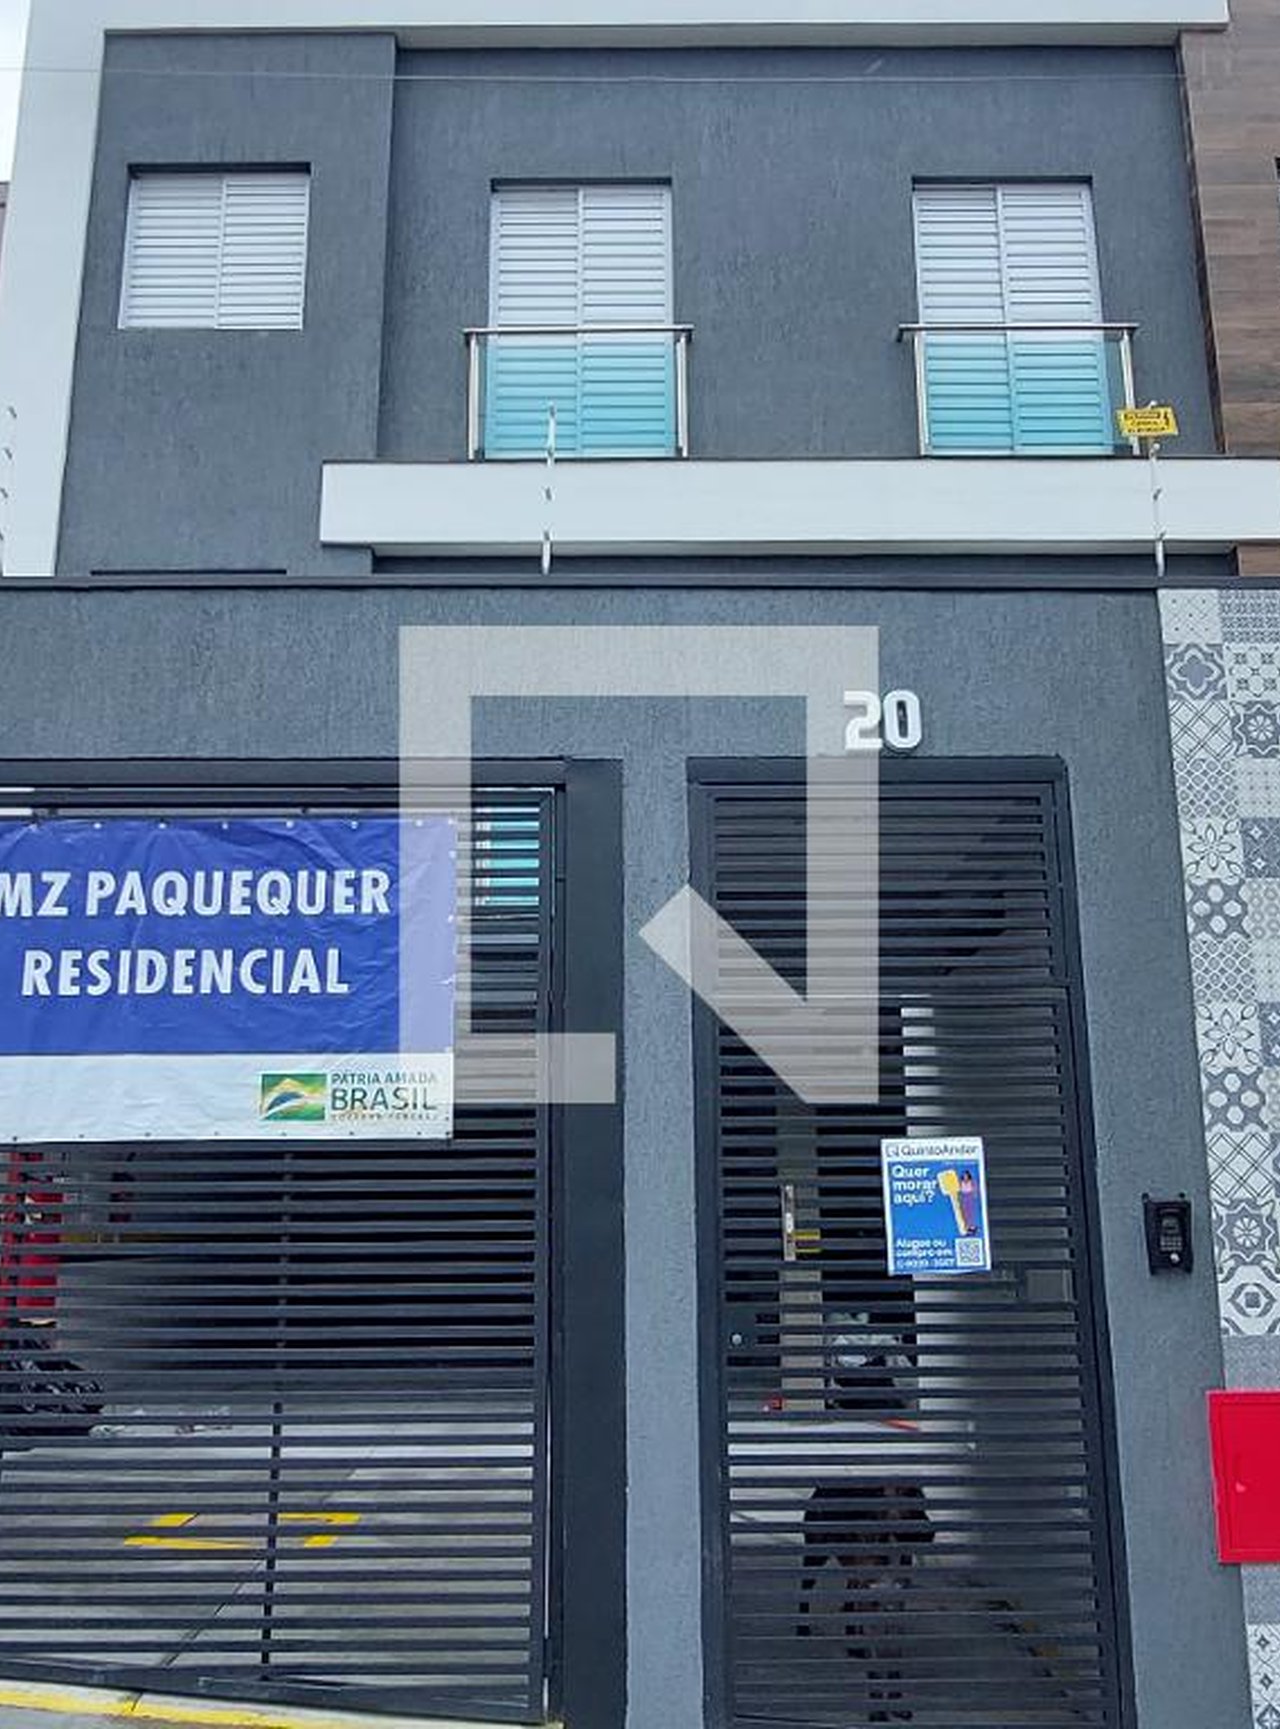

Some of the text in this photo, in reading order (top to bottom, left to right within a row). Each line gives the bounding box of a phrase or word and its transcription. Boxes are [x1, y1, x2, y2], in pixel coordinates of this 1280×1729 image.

[843, 690, 922, 750] 20
[86, 869, 391, 916] PAQUEQUER
[21, 948, 351, 996] RESIDENCIAL
[331, 1086, 437, 1111] BRASIL
[901, 1143, 979, 1156] QuintoAndar
[891, 1164, 930, 1179] Quer
[892, 1179, 937, 1191] morar
[893, 1190, 935, 1207] aqui?
[933, 1239, 947, 1247] ou
